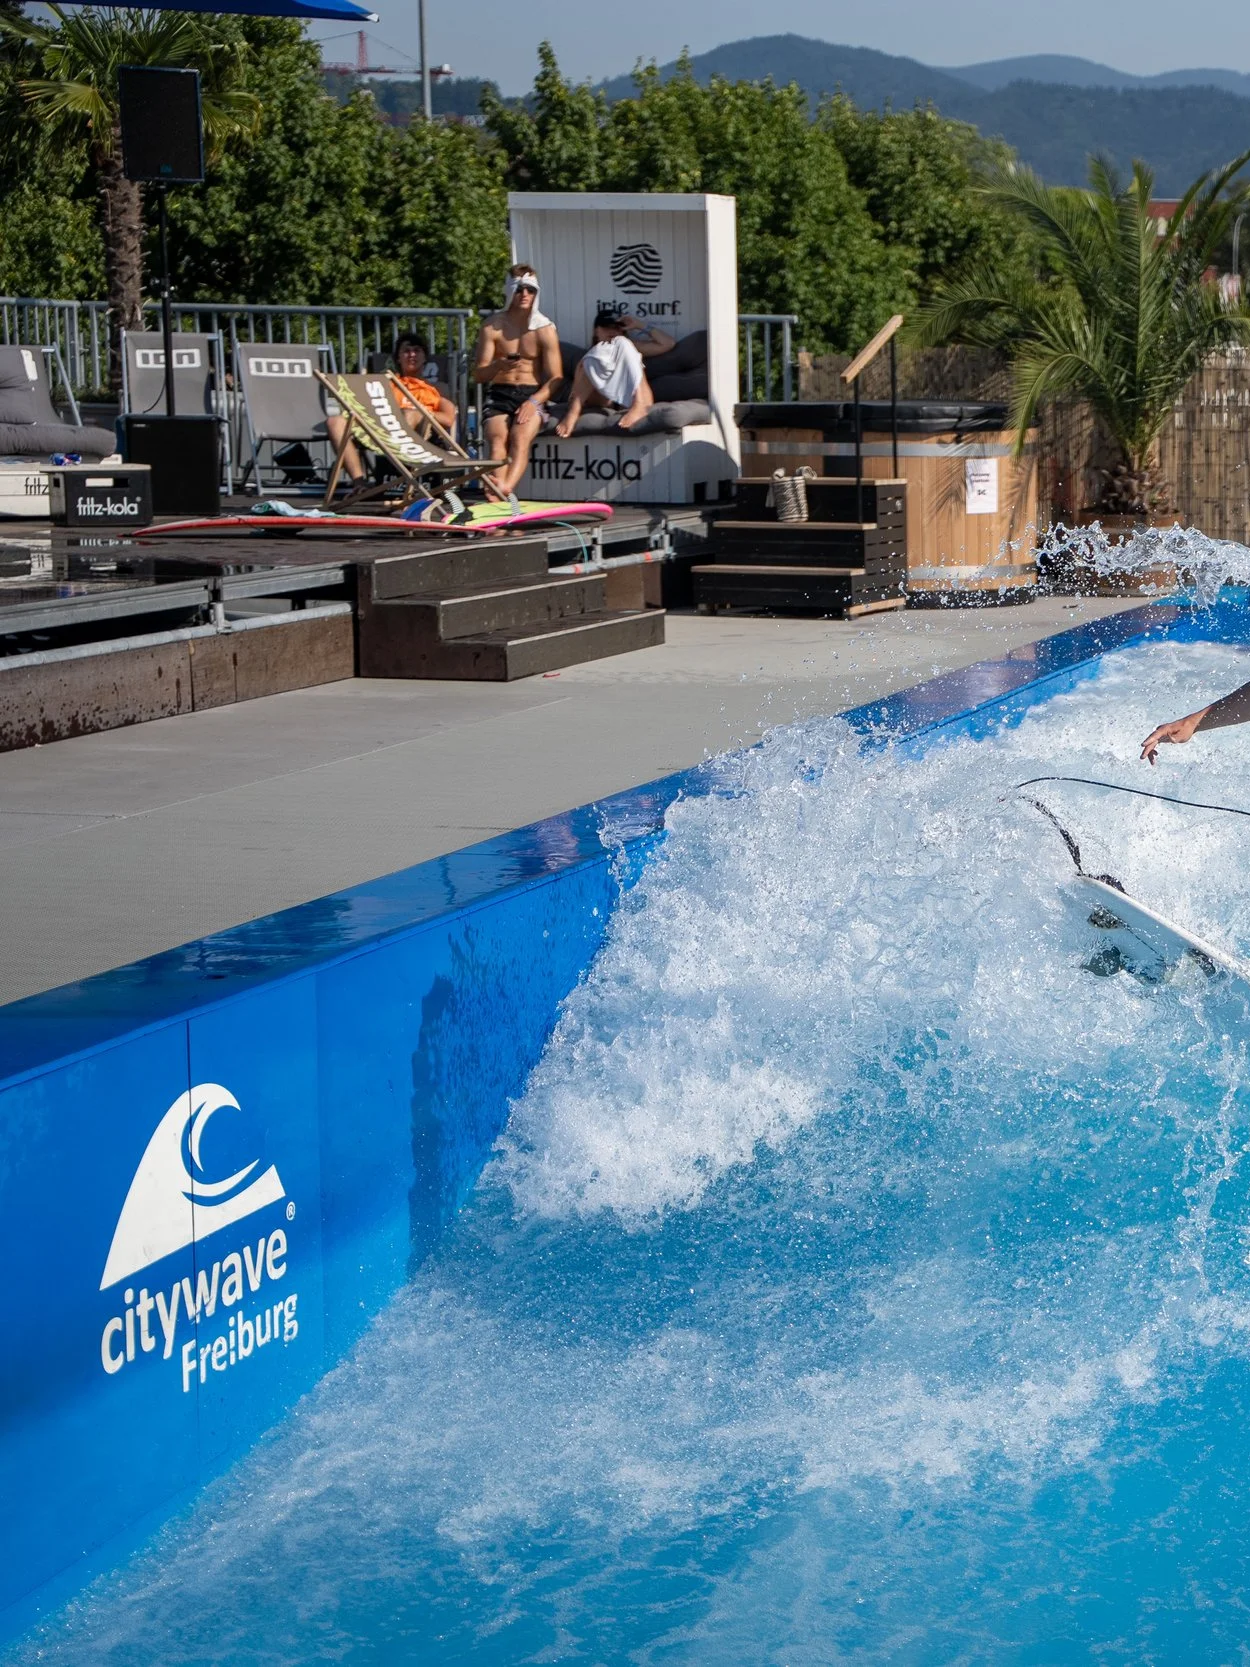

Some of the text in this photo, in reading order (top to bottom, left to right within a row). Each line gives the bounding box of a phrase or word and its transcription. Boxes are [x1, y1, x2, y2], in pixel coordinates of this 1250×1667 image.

[529, 444, 641, 480] fritz-kola
[76, 496, 139, 516] fritz-kola
[101, 1228, 287, 1374] citywave
[181, 1293, 298, 1393] Freiburg
